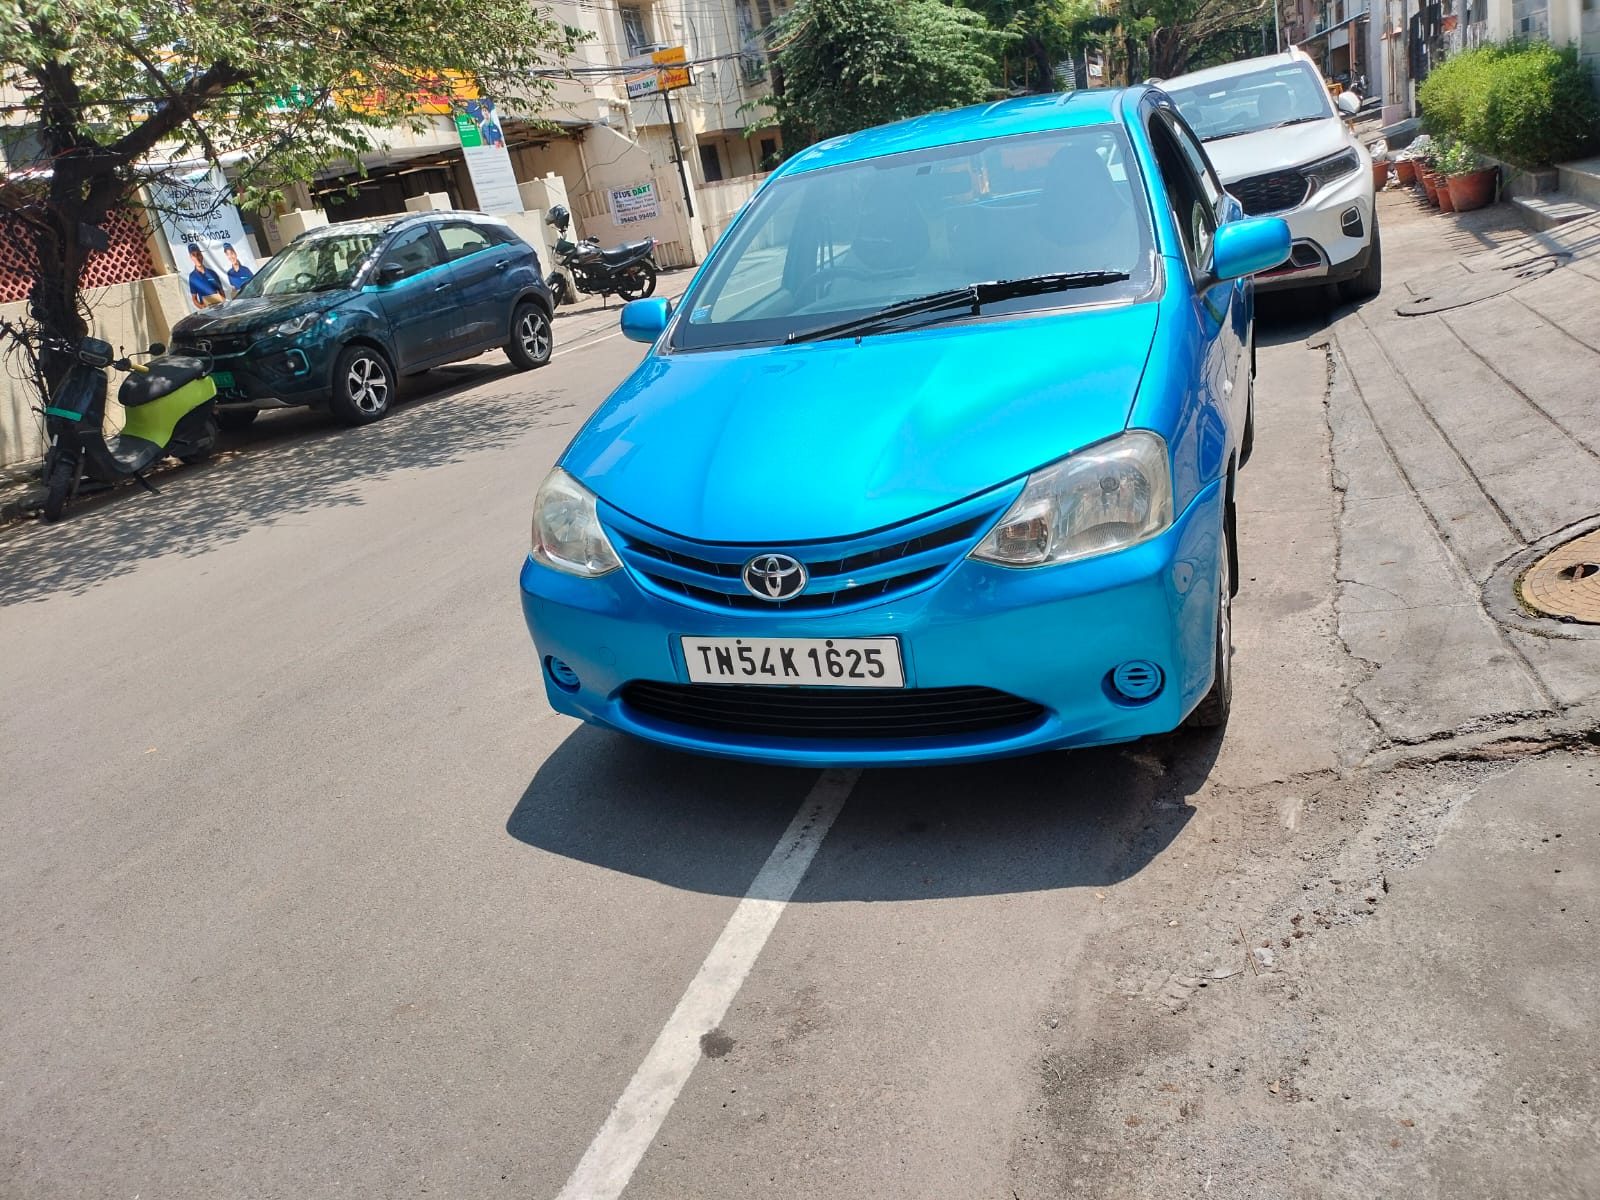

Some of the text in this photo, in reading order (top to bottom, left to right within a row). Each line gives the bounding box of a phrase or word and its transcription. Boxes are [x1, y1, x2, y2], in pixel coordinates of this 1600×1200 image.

[632, 184, 651, 196] DART
[178, 209, 222, 222] AOCIATES
[808, 647, 885, 679] 1625
